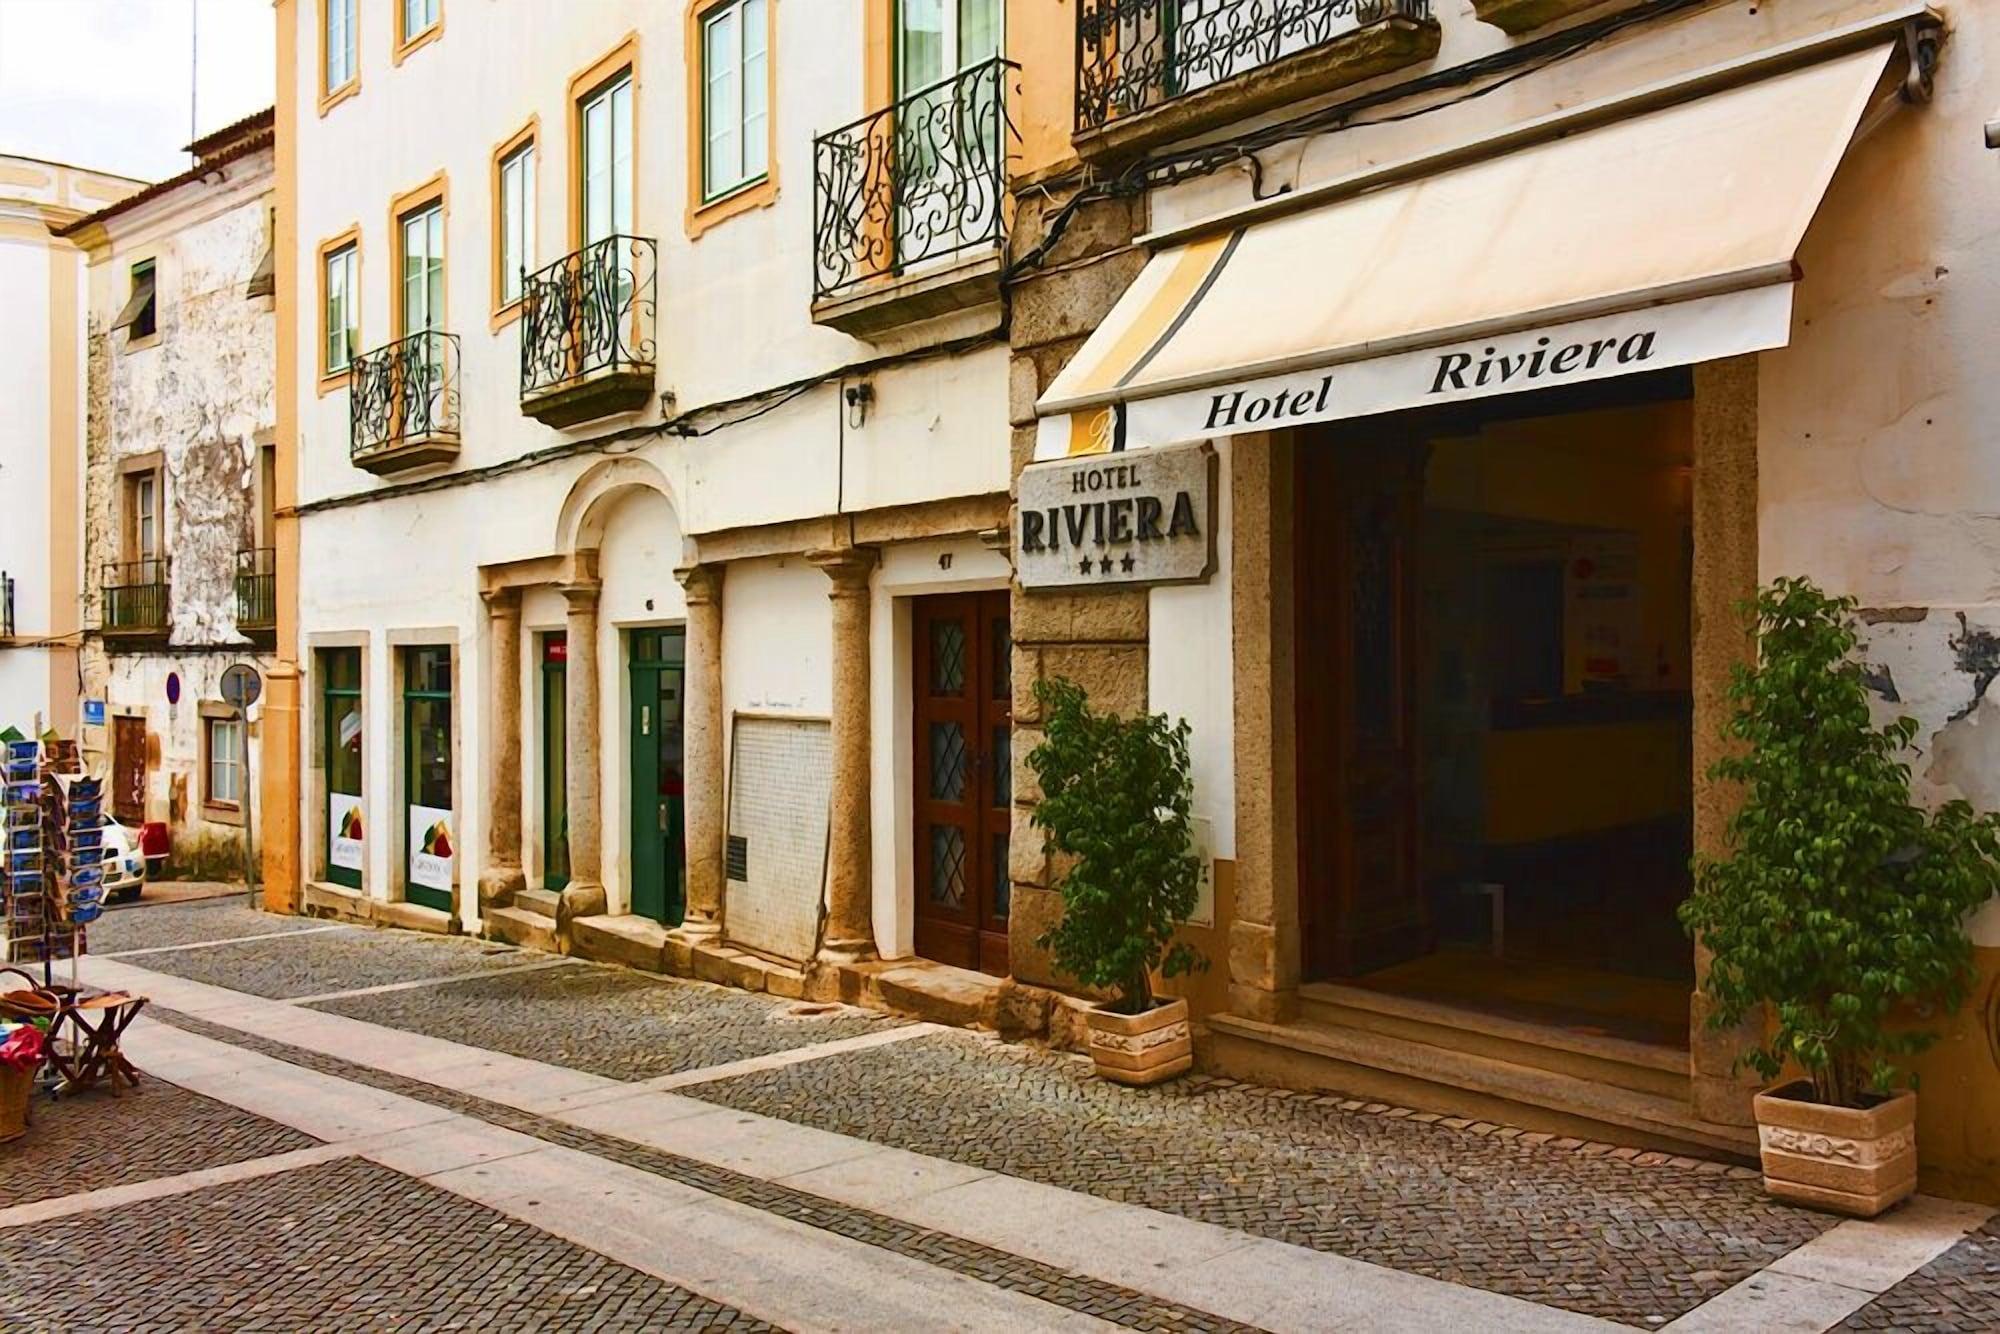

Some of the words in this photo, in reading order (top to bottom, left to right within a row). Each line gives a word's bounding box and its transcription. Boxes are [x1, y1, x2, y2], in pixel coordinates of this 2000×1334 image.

[1201, 375, 1334, 430] Hotel
[1425, 330, 1657, 394] Riviera
[1072, 465, 1141, 493] HOTEL
[1021, 491, 1200, 553] RIVIERA
